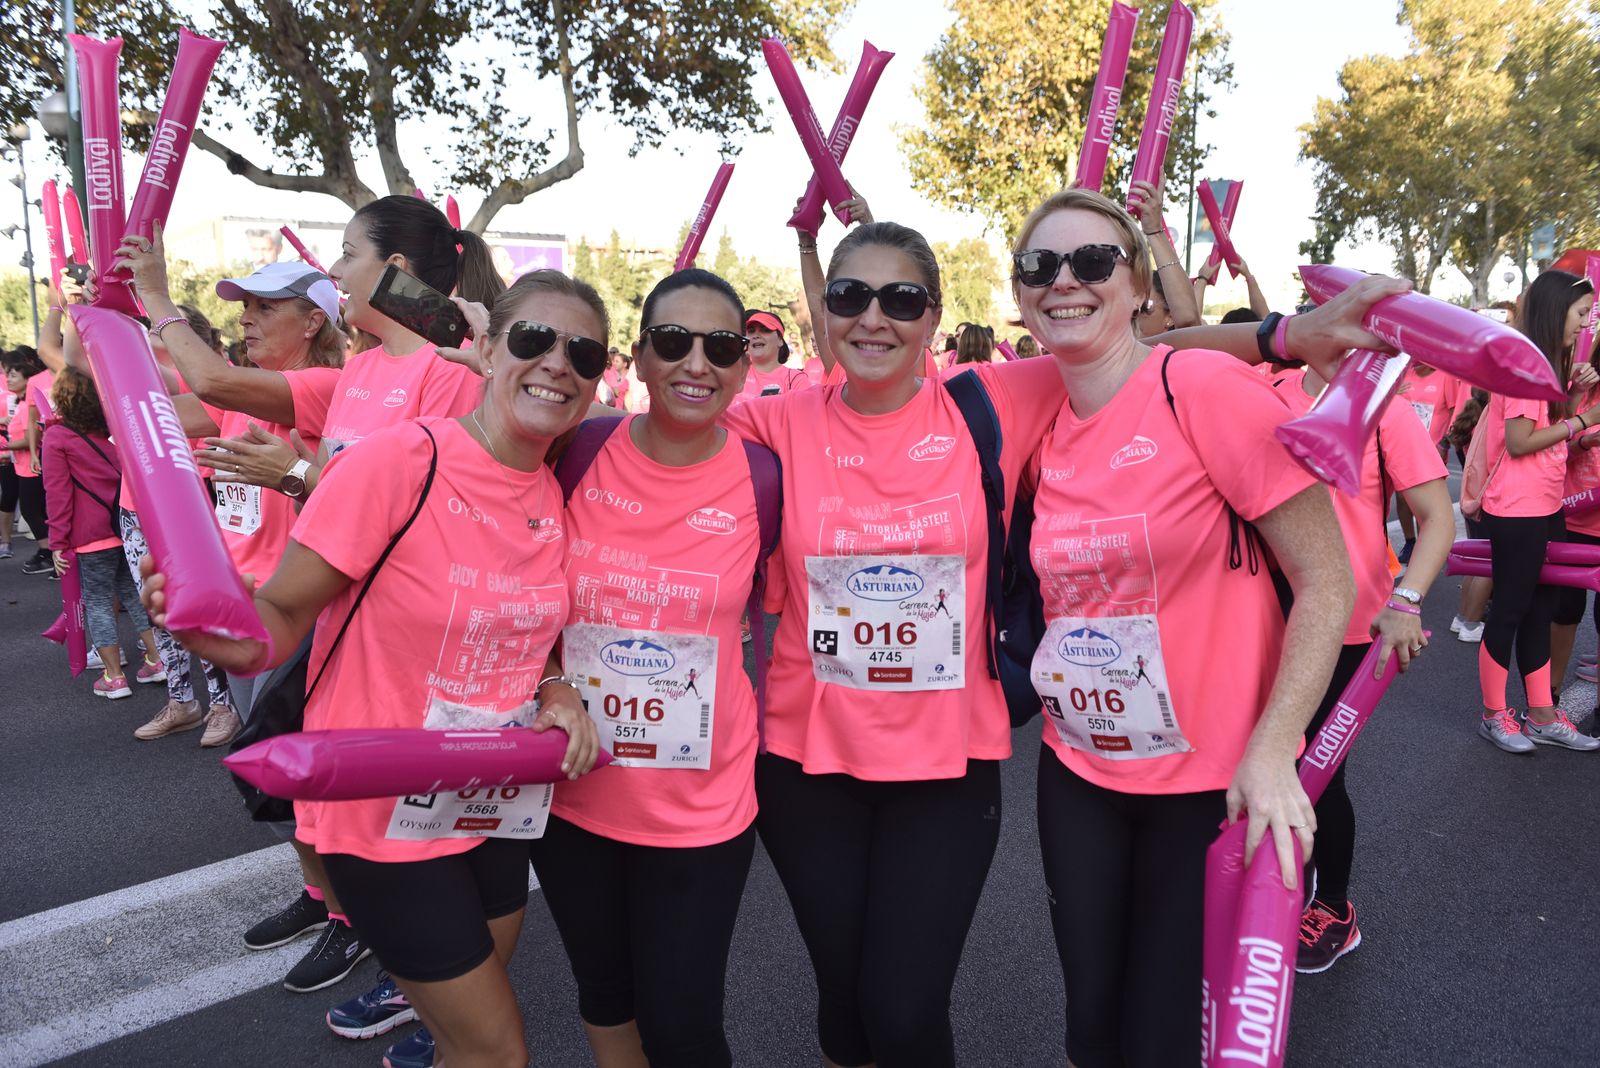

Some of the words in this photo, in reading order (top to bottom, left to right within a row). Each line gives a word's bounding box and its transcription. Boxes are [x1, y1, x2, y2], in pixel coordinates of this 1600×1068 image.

[1093, 85, 1121, 145] Ladival
[831, 115, 860, 168] Ladiva
[145, 118, 188, 191] Ladival
[85, 137, 112, 210] Ladival
[226, 484, 247, 502] 016
[585, 487, 643, 515] OYSHO
[863, 523, 900, 535] VITORIA
[909, 512, 950, 530] GASTEIZ
[883, 529, 924, 543] MADRID
[1053, 538, 1082, 551] VITORIA
[1089, 534, 1128, 549] GASTEIZ
[1067, 549, 1104, 563] MADRID
[606, 572, 647, 590] VITORIA
[657, 582, 701, 600] GASTEIZ
[853, 578, 918, 592] ASTURIANA
[626, 589, 669, 607] MADRID
[898, 601, 929, 610] Carrera
[499, 602, 529, 617] VITORIA
[853, 622, 918, 645] 016
[869, 651, 903, 663] 4745
[1062, 641, 1116, 658] ASTURIANA
[605, 649, 669, 669] ASTURIANA
[818, 664, 854, 678] OYSHO
[927, 674, 954, 682] ZURICH
[1101, 667, 1129, 677] Carrera
[427, 672, 481, 696] BARCELONA
[647, 676, 678, 687] Carrera
[603, 694, 665, 722] 016
[1069, 687, 1126, 714] 016
[615, 725, 647, 739] 5571
[1087, 718, 1115, 731] 5570
[1304, 701, 1359, 770] Ladival
[464, 804, 499, 815] 5568
[399, 818, 442, 831] OYSHO
[1220, 937, 1284, 1068] Ladival
